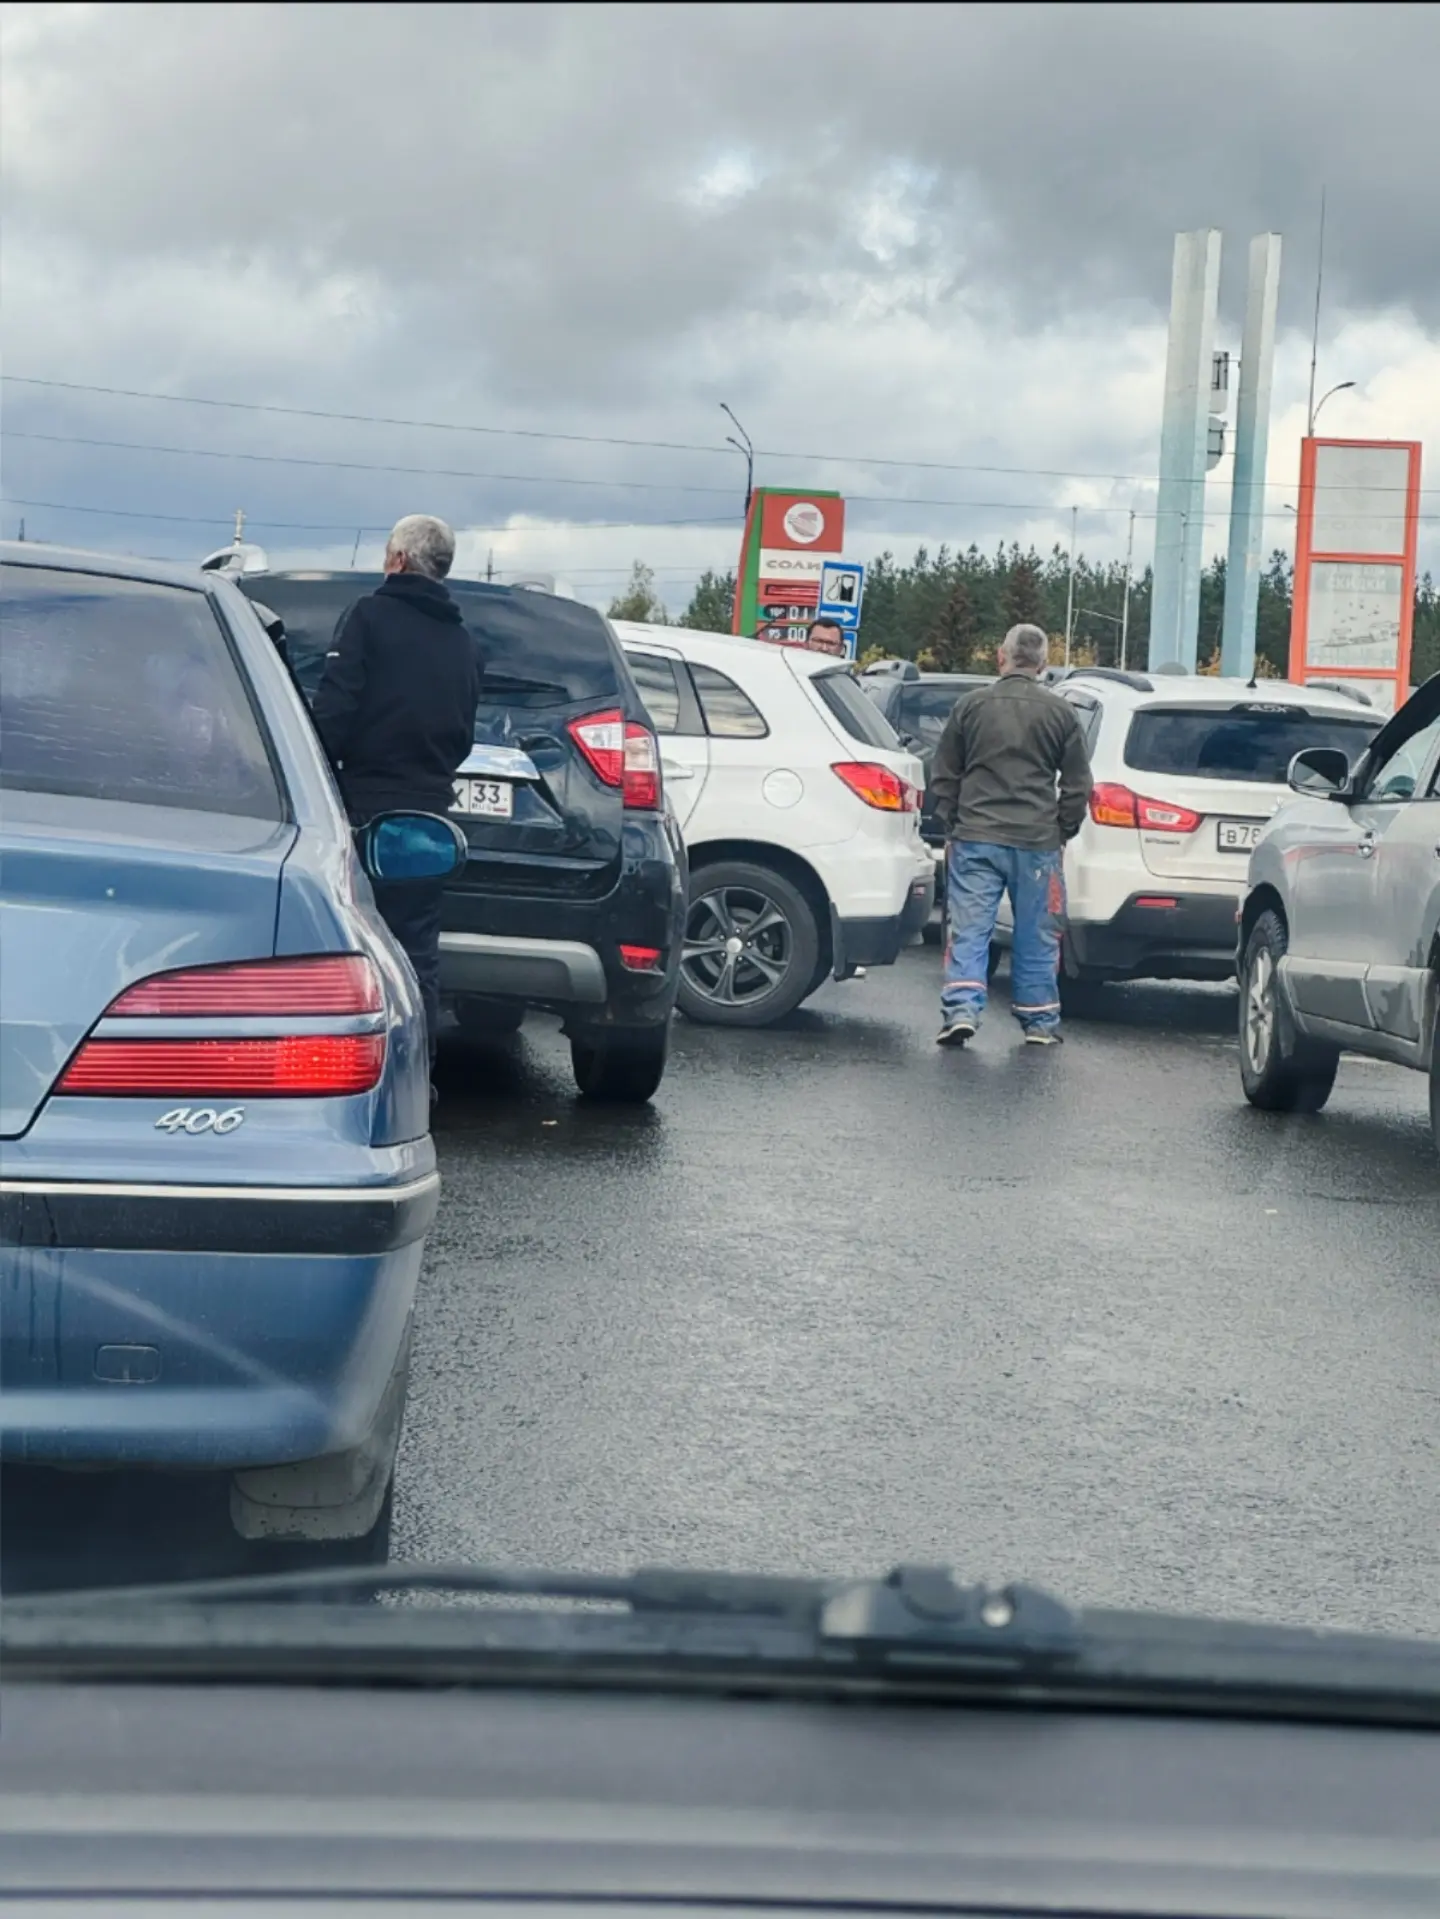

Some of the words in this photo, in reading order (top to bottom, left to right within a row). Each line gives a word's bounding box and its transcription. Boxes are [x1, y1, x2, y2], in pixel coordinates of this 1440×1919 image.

[765, 559, 821, 571] СОЛИ
[473, 782, 501, 804] 33
[154, 1106, 246, 1135] 406
